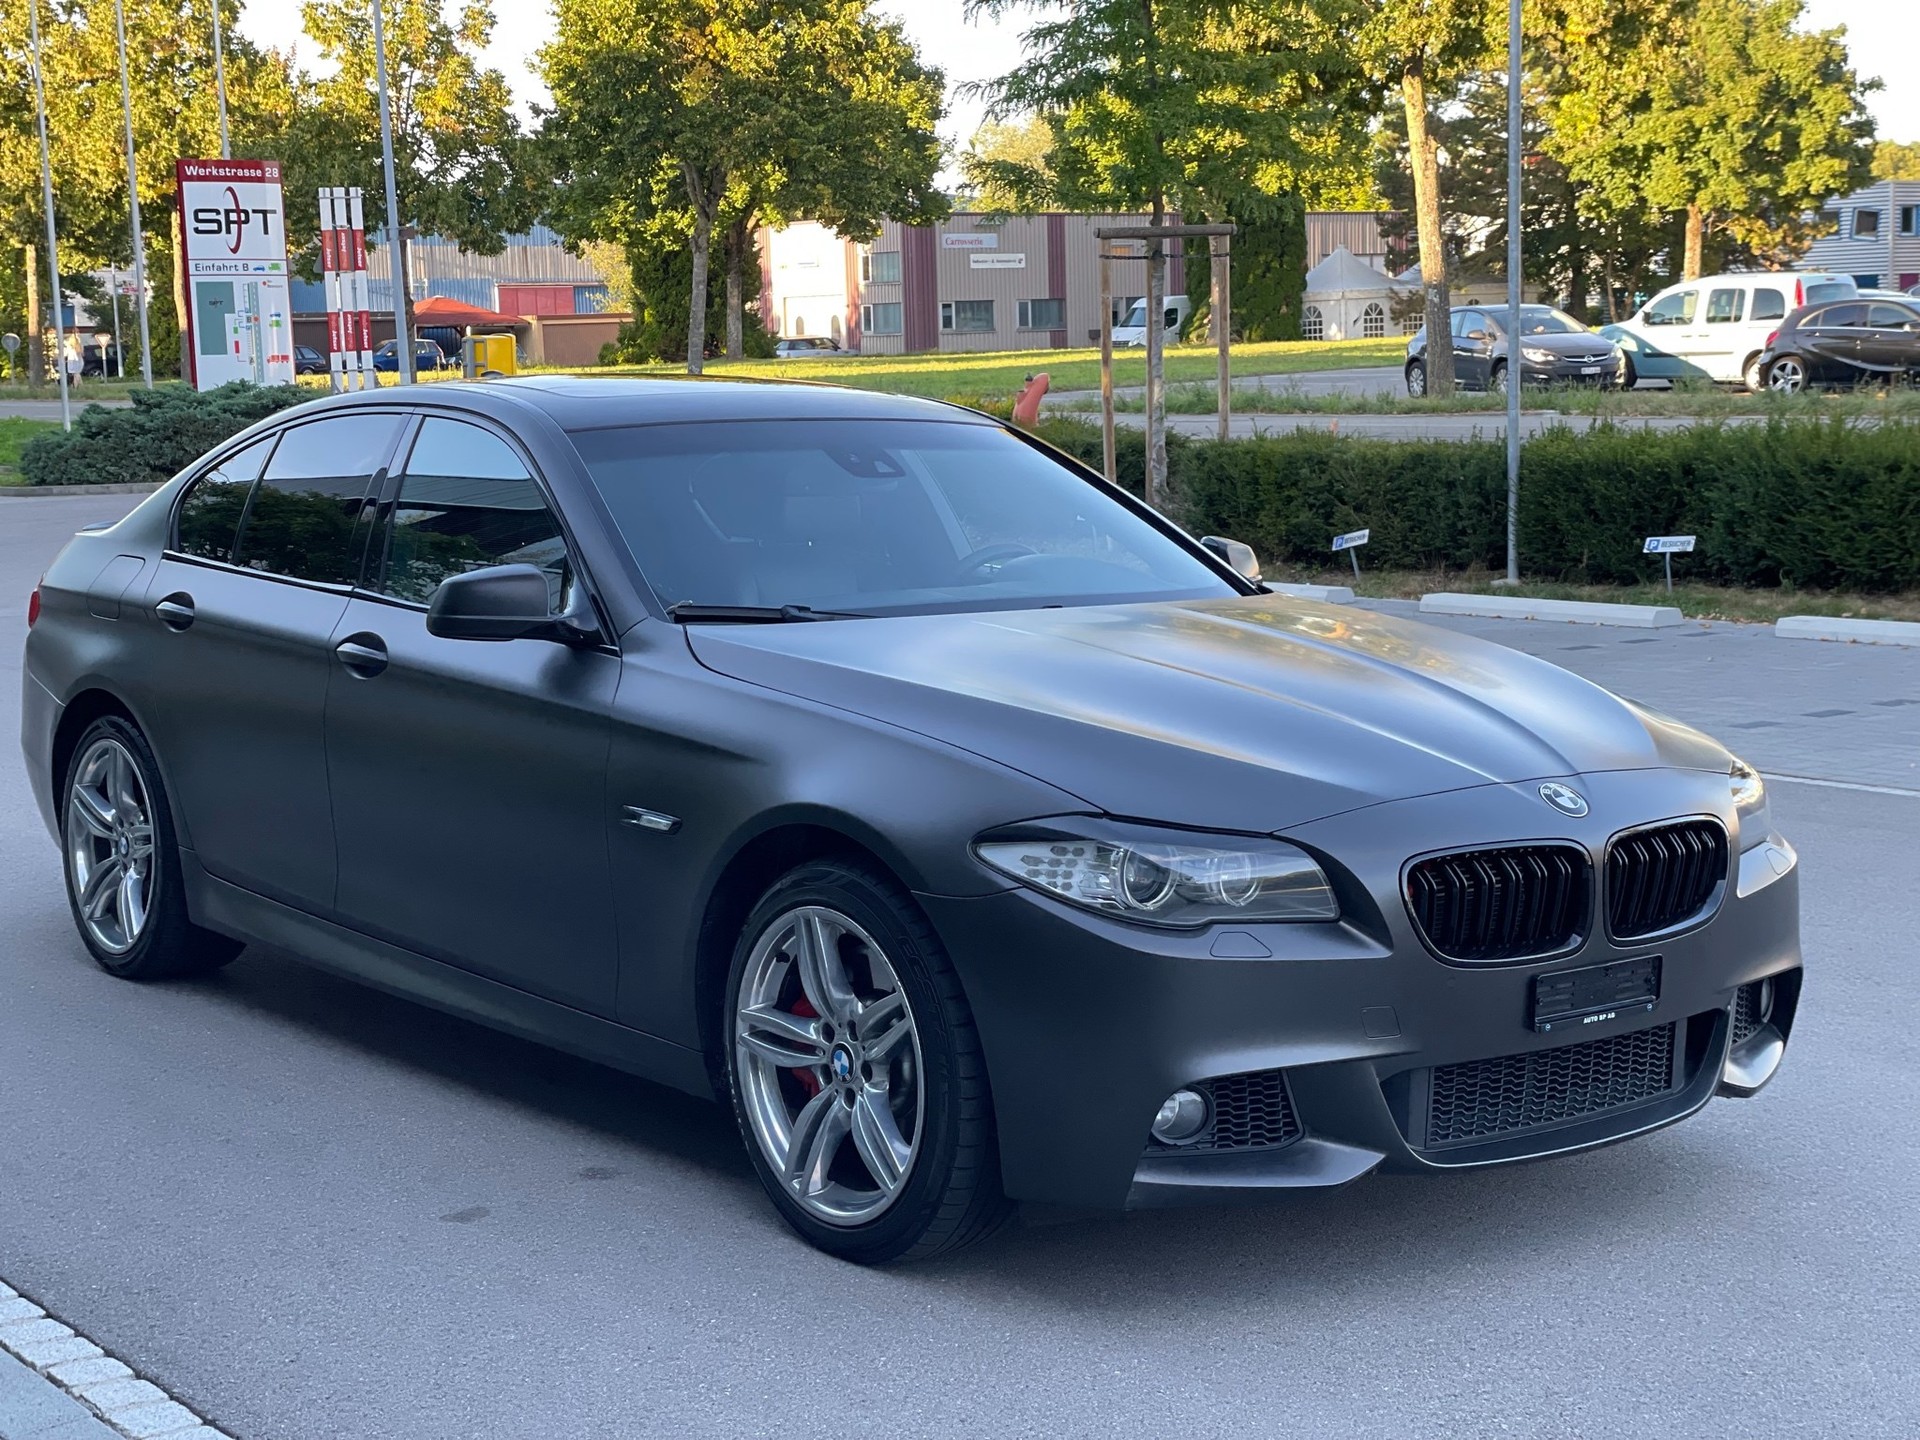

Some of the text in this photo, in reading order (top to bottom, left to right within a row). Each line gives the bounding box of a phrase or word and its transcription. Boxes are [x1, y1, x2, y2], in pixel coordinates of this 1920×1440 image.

[184, 165, 279, 178] Werkstrasse 28
[193, 208, 277, 235] SPT
[194, 262, 249, 272] Einfahrt B
[1584, 1016, 1598, 1024] AUTO
